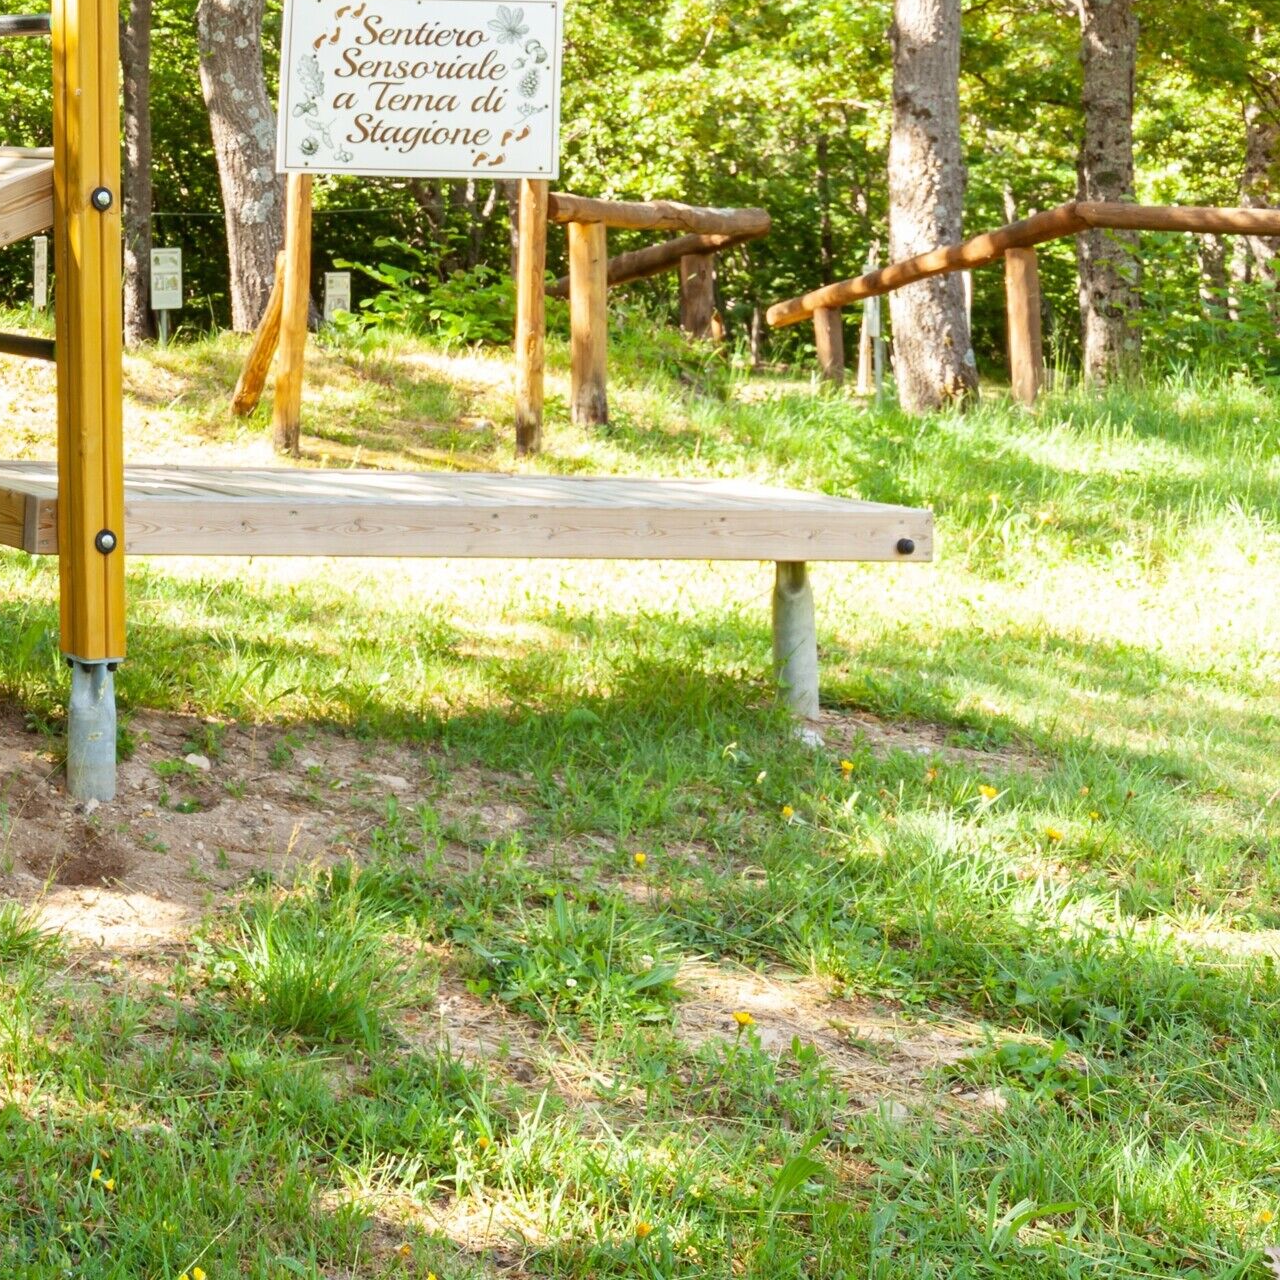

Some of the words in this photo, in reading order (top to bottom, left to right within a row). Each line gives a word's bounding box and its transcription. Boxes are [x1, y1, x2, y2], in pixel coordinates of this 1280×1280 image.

[356, 15, 489, 47] Sentiero
[334, 47, 508, 80] Sensoriale
[332, 92, 359, 110] a
[368, 81, 460, 112] Tema
[471, 86, 508, 113] di
[346, 113, 492, 153] Stagione
